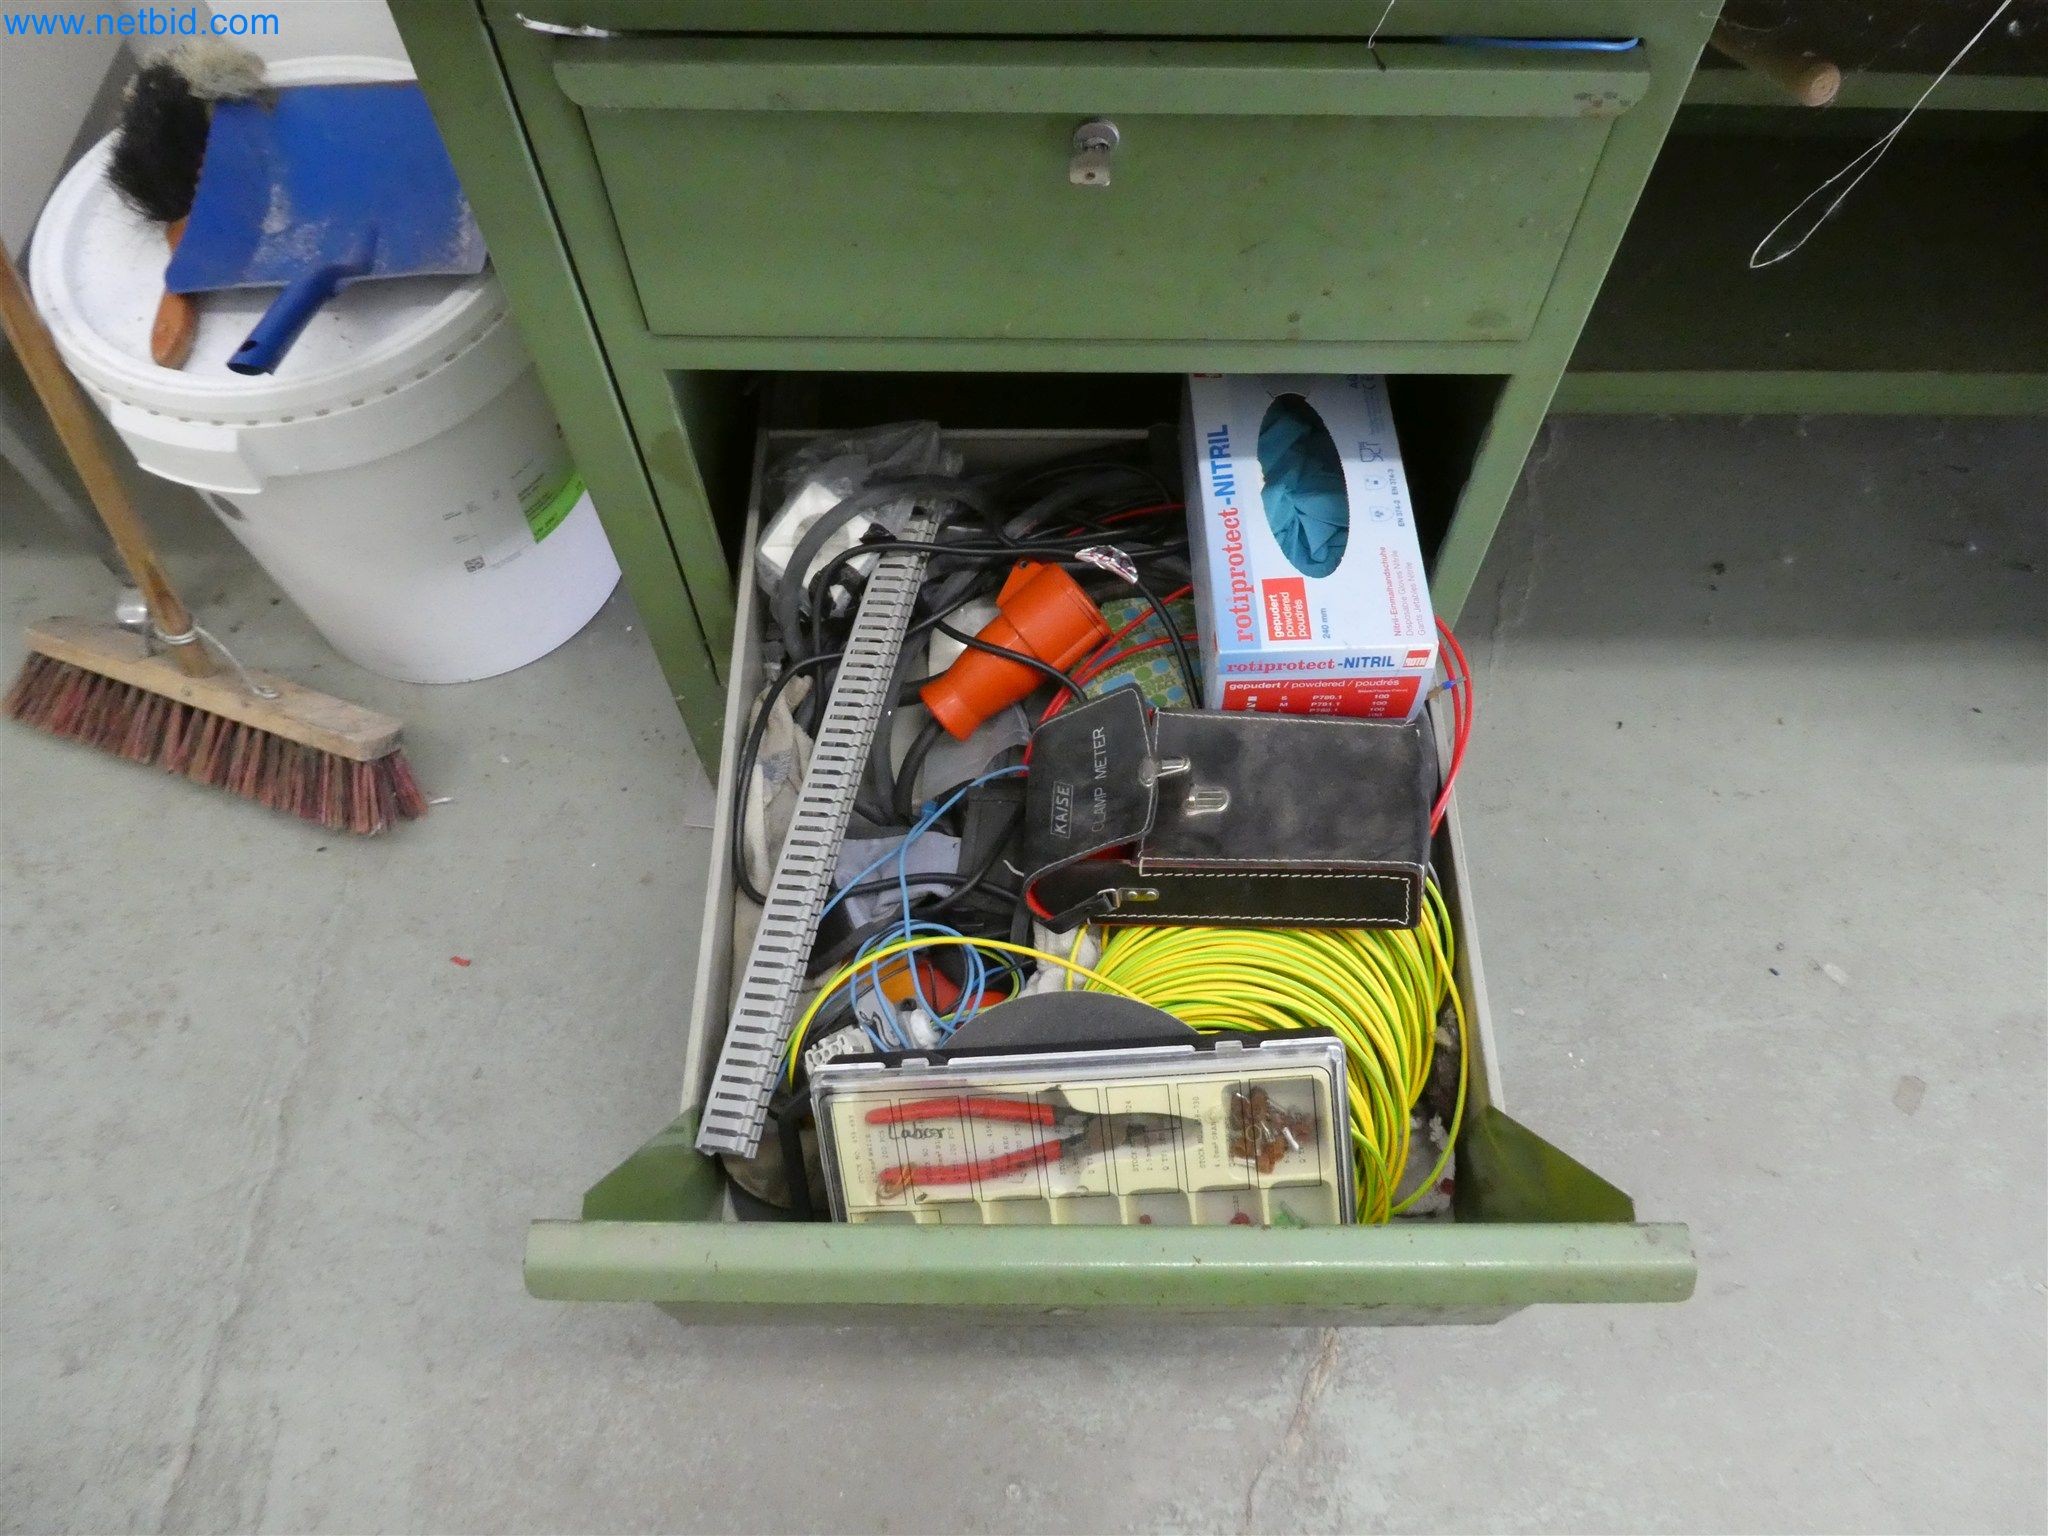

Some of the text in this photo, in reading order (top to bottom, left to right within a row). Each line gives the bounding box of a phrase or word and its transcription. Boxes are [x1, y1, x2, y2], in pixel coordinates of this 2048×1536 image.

[1218, 507, 1255, 641] rotiprotect
[1395, 570, 1406, 595] Gloves
[1268, 594, 1284, 637] gepudert
[1279, 592, 1297, 637] powdered
[1293, 599, 1309, 636] poudrés
[1320, 608, 1331, 639] 240 mm
[1400, 597, 1414, 636] Disposable
[1227, 658, 1335, 673] rotiprotect
[1229, 681, 1281, 690] gepudert
[1291, 680, 1345, 689] powdered
[1354, 679, 1400, 687] poudrés
[1092, 726, 1107, 832] CLAMP METER
[1055, 785, 1070, 834] KAISE
